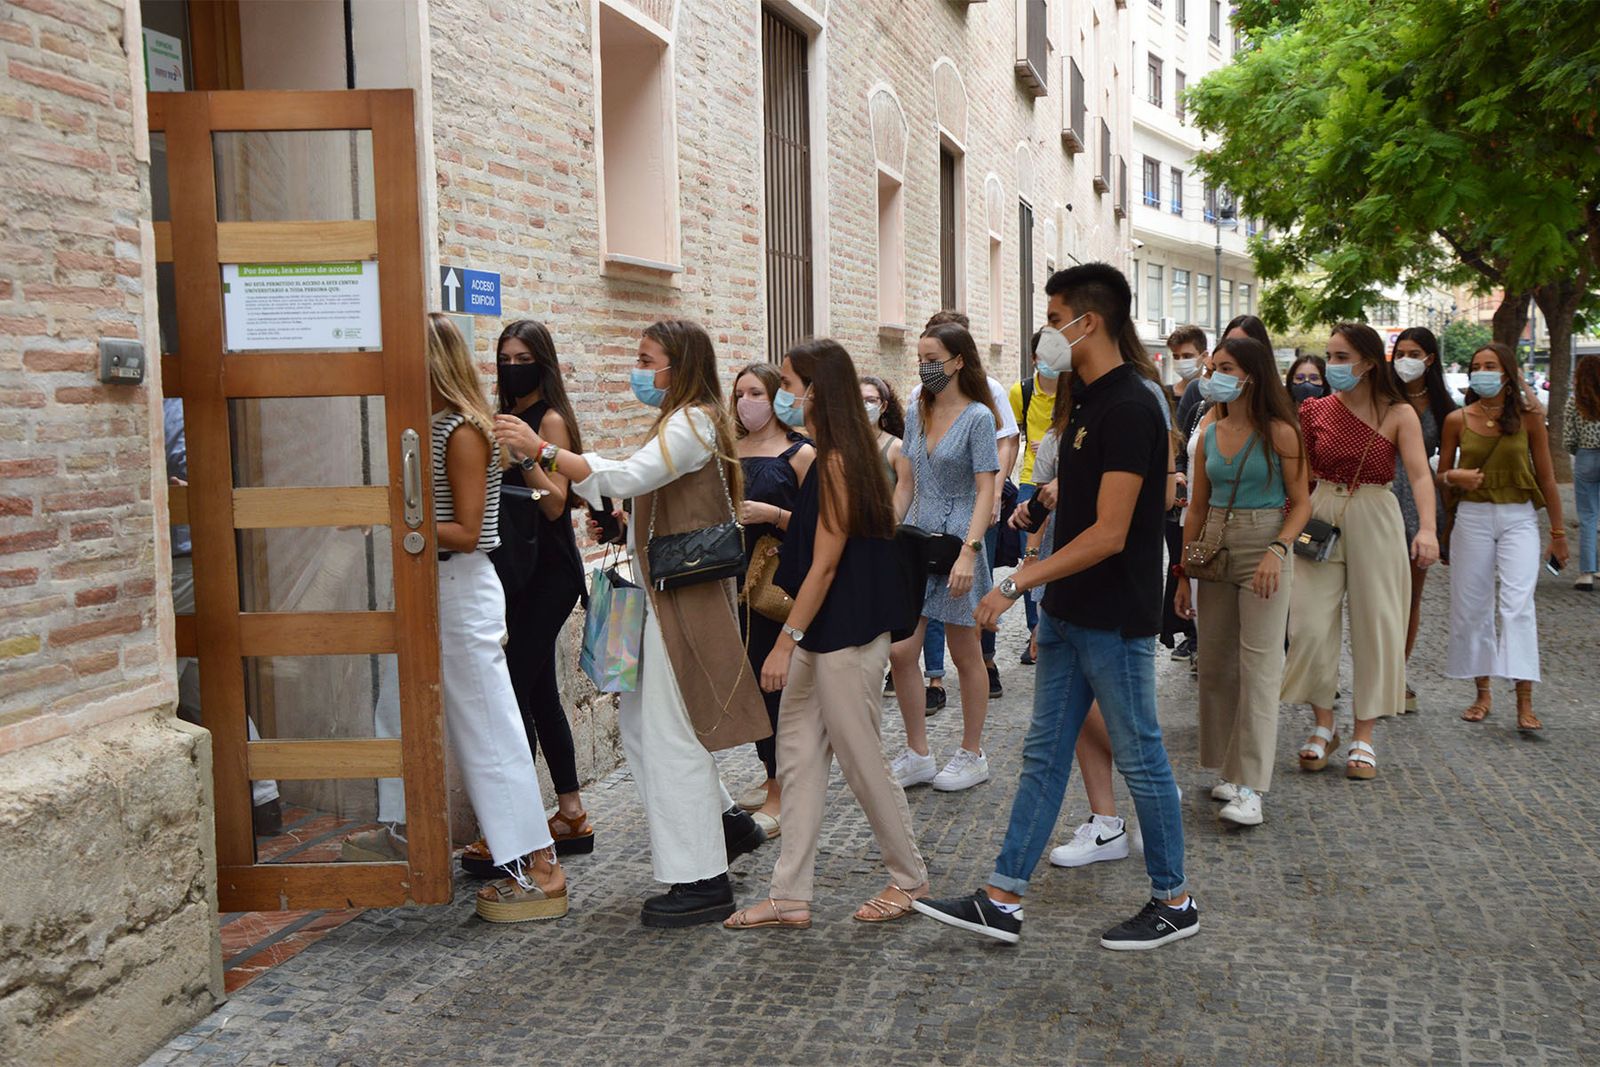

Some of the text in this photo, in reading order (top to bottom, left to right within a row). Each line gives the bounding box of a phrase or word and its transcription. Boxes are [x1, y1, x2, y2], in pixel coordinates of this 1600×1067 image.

[243, 264, 358, 275] Por favor, lea antes de acceder
[472, 279, 495, 292] ACCESO
[471, 294, 496, 306] EDIFICIO
